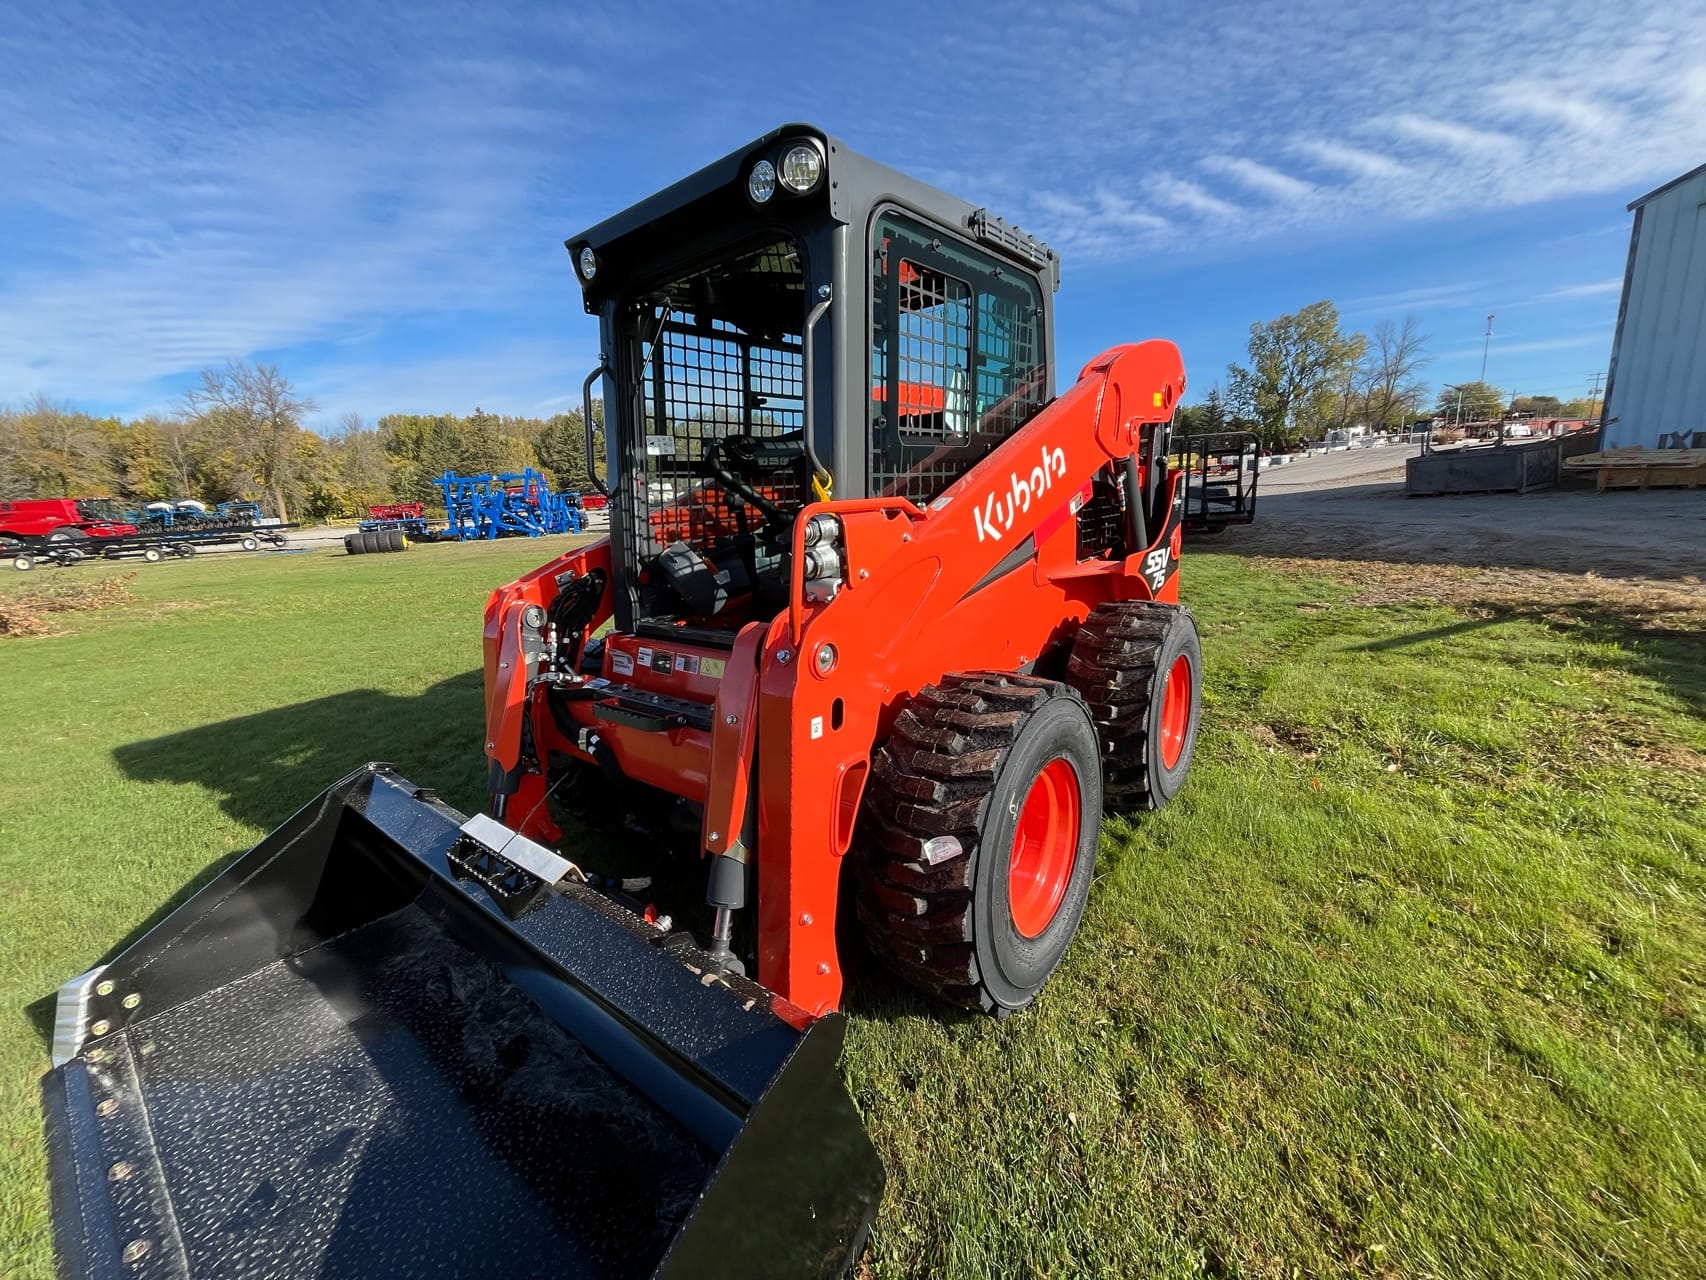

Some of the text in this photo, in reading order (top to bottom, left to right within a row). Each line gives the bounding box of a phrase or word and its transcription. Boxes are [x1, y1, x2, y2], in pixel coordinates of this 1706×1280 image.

[973, 445, 1067, 543] Kubota
[1145, 546, 1171, 575] SSV
[1152, 569, 1166, 590] 75
